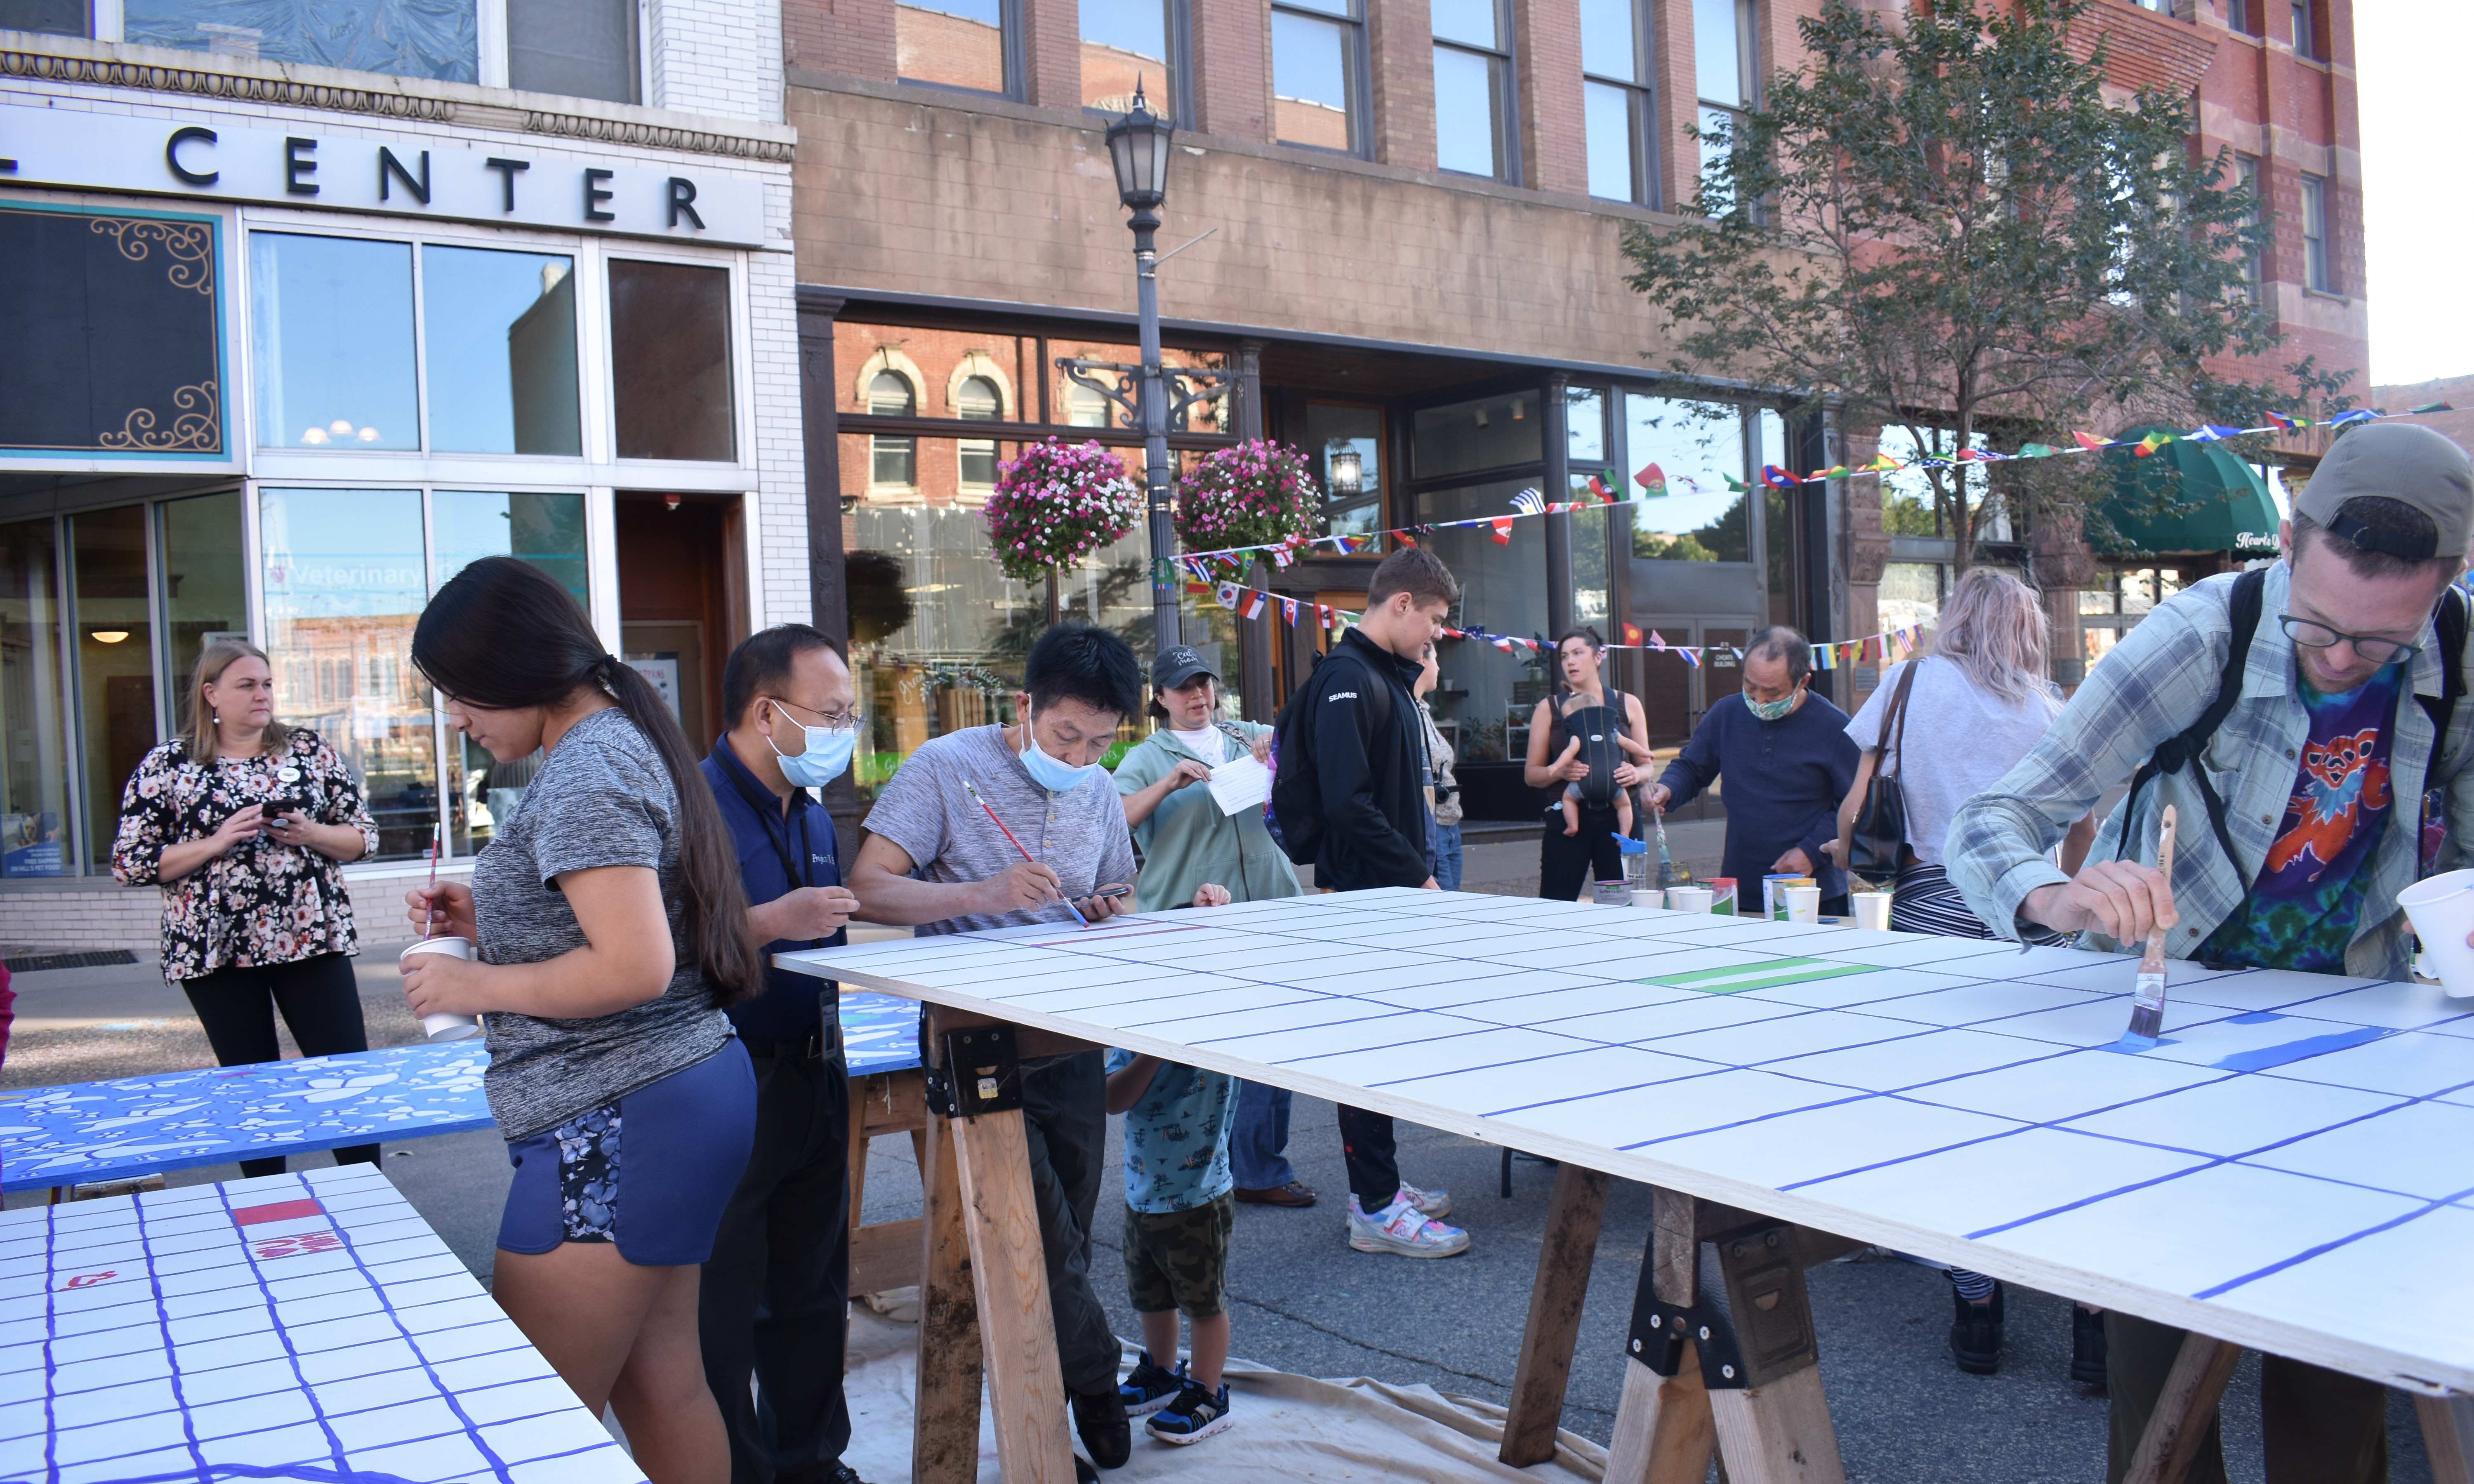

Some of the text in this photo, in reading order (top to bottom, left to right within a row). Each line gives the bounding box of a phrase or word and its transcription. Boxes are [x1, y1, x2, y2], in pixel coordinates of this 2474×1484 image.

[165, 126, 706, 230] CENTER
[293, 564, 421, 587] Veterinary
[1329, 692, 1357, 702] SEAMUS
